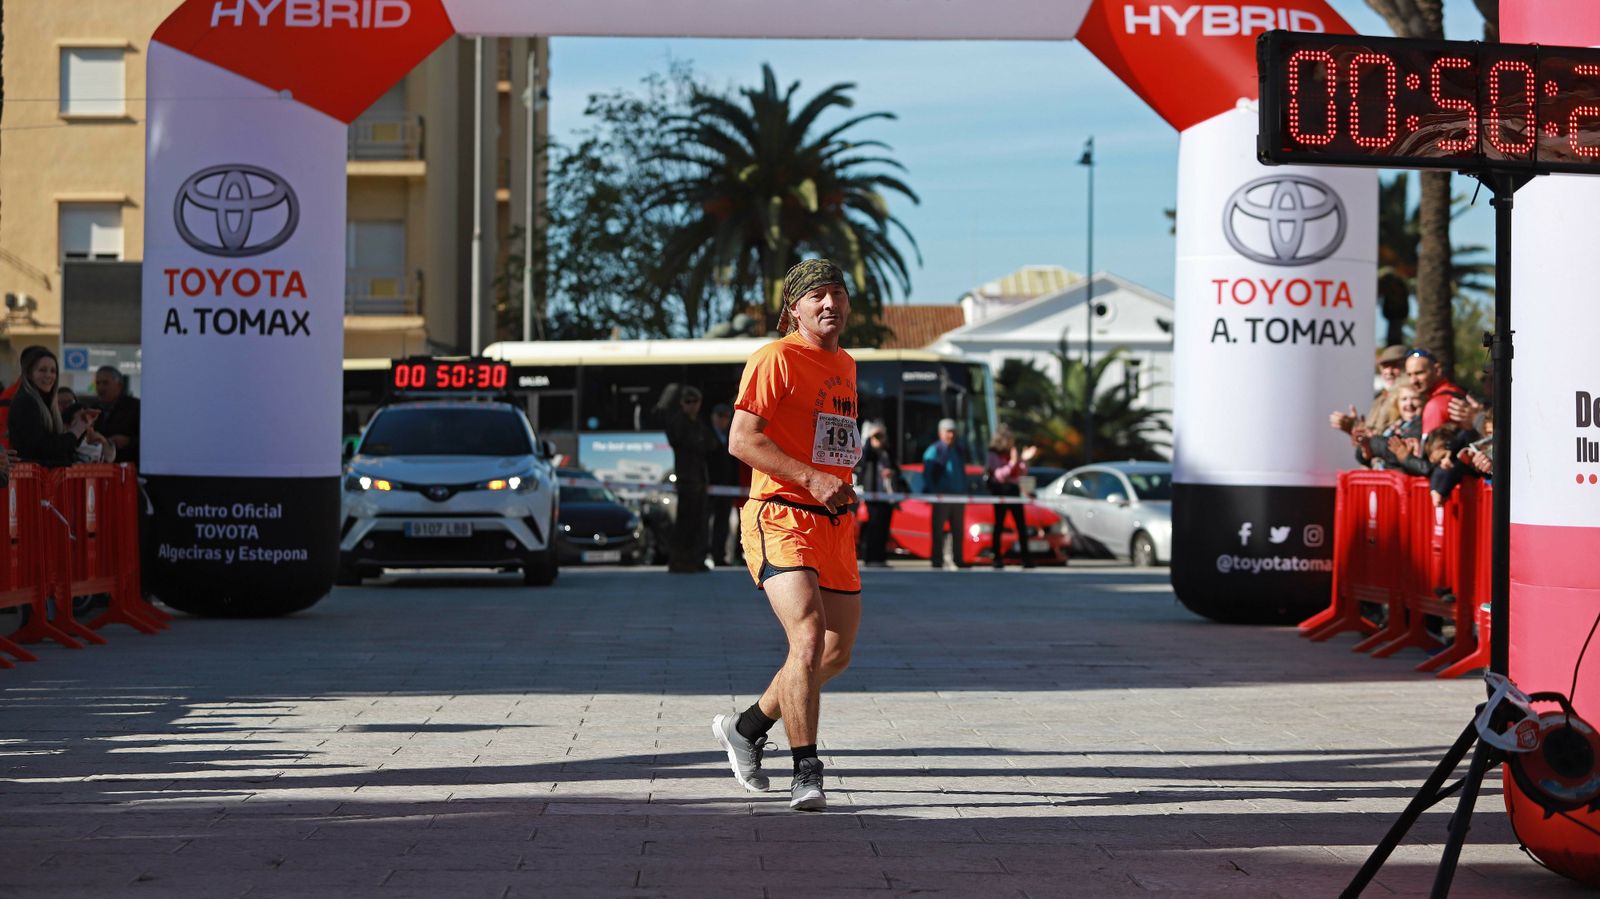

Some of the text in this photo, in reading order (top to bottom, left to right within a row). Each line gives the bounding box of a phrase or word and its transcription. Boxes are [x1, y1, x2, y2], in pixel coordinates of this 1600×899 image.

[210, 0, 411, 29] HYBRID
[1124, 5, 1325, 36] HYBRID
[164, 267, 307, 298] TOYOTA
[1211, 278, 1353, 308] TOYOTA
[163, 307, 311, 337] A. TOMAX
[1211, 317, 1356, 347] A. TOMAX
[395, 364, 507, 388] 00 50:30
[826, 426, 855, 448] 191
[177, 502, 283, 519] Centro Oficial
[195, 523, 259, 540] TOYOTA
[158, 543, 308, 564] Algeciras y Estepona
[1216, 554, 1333, 575] @toyotatoma
